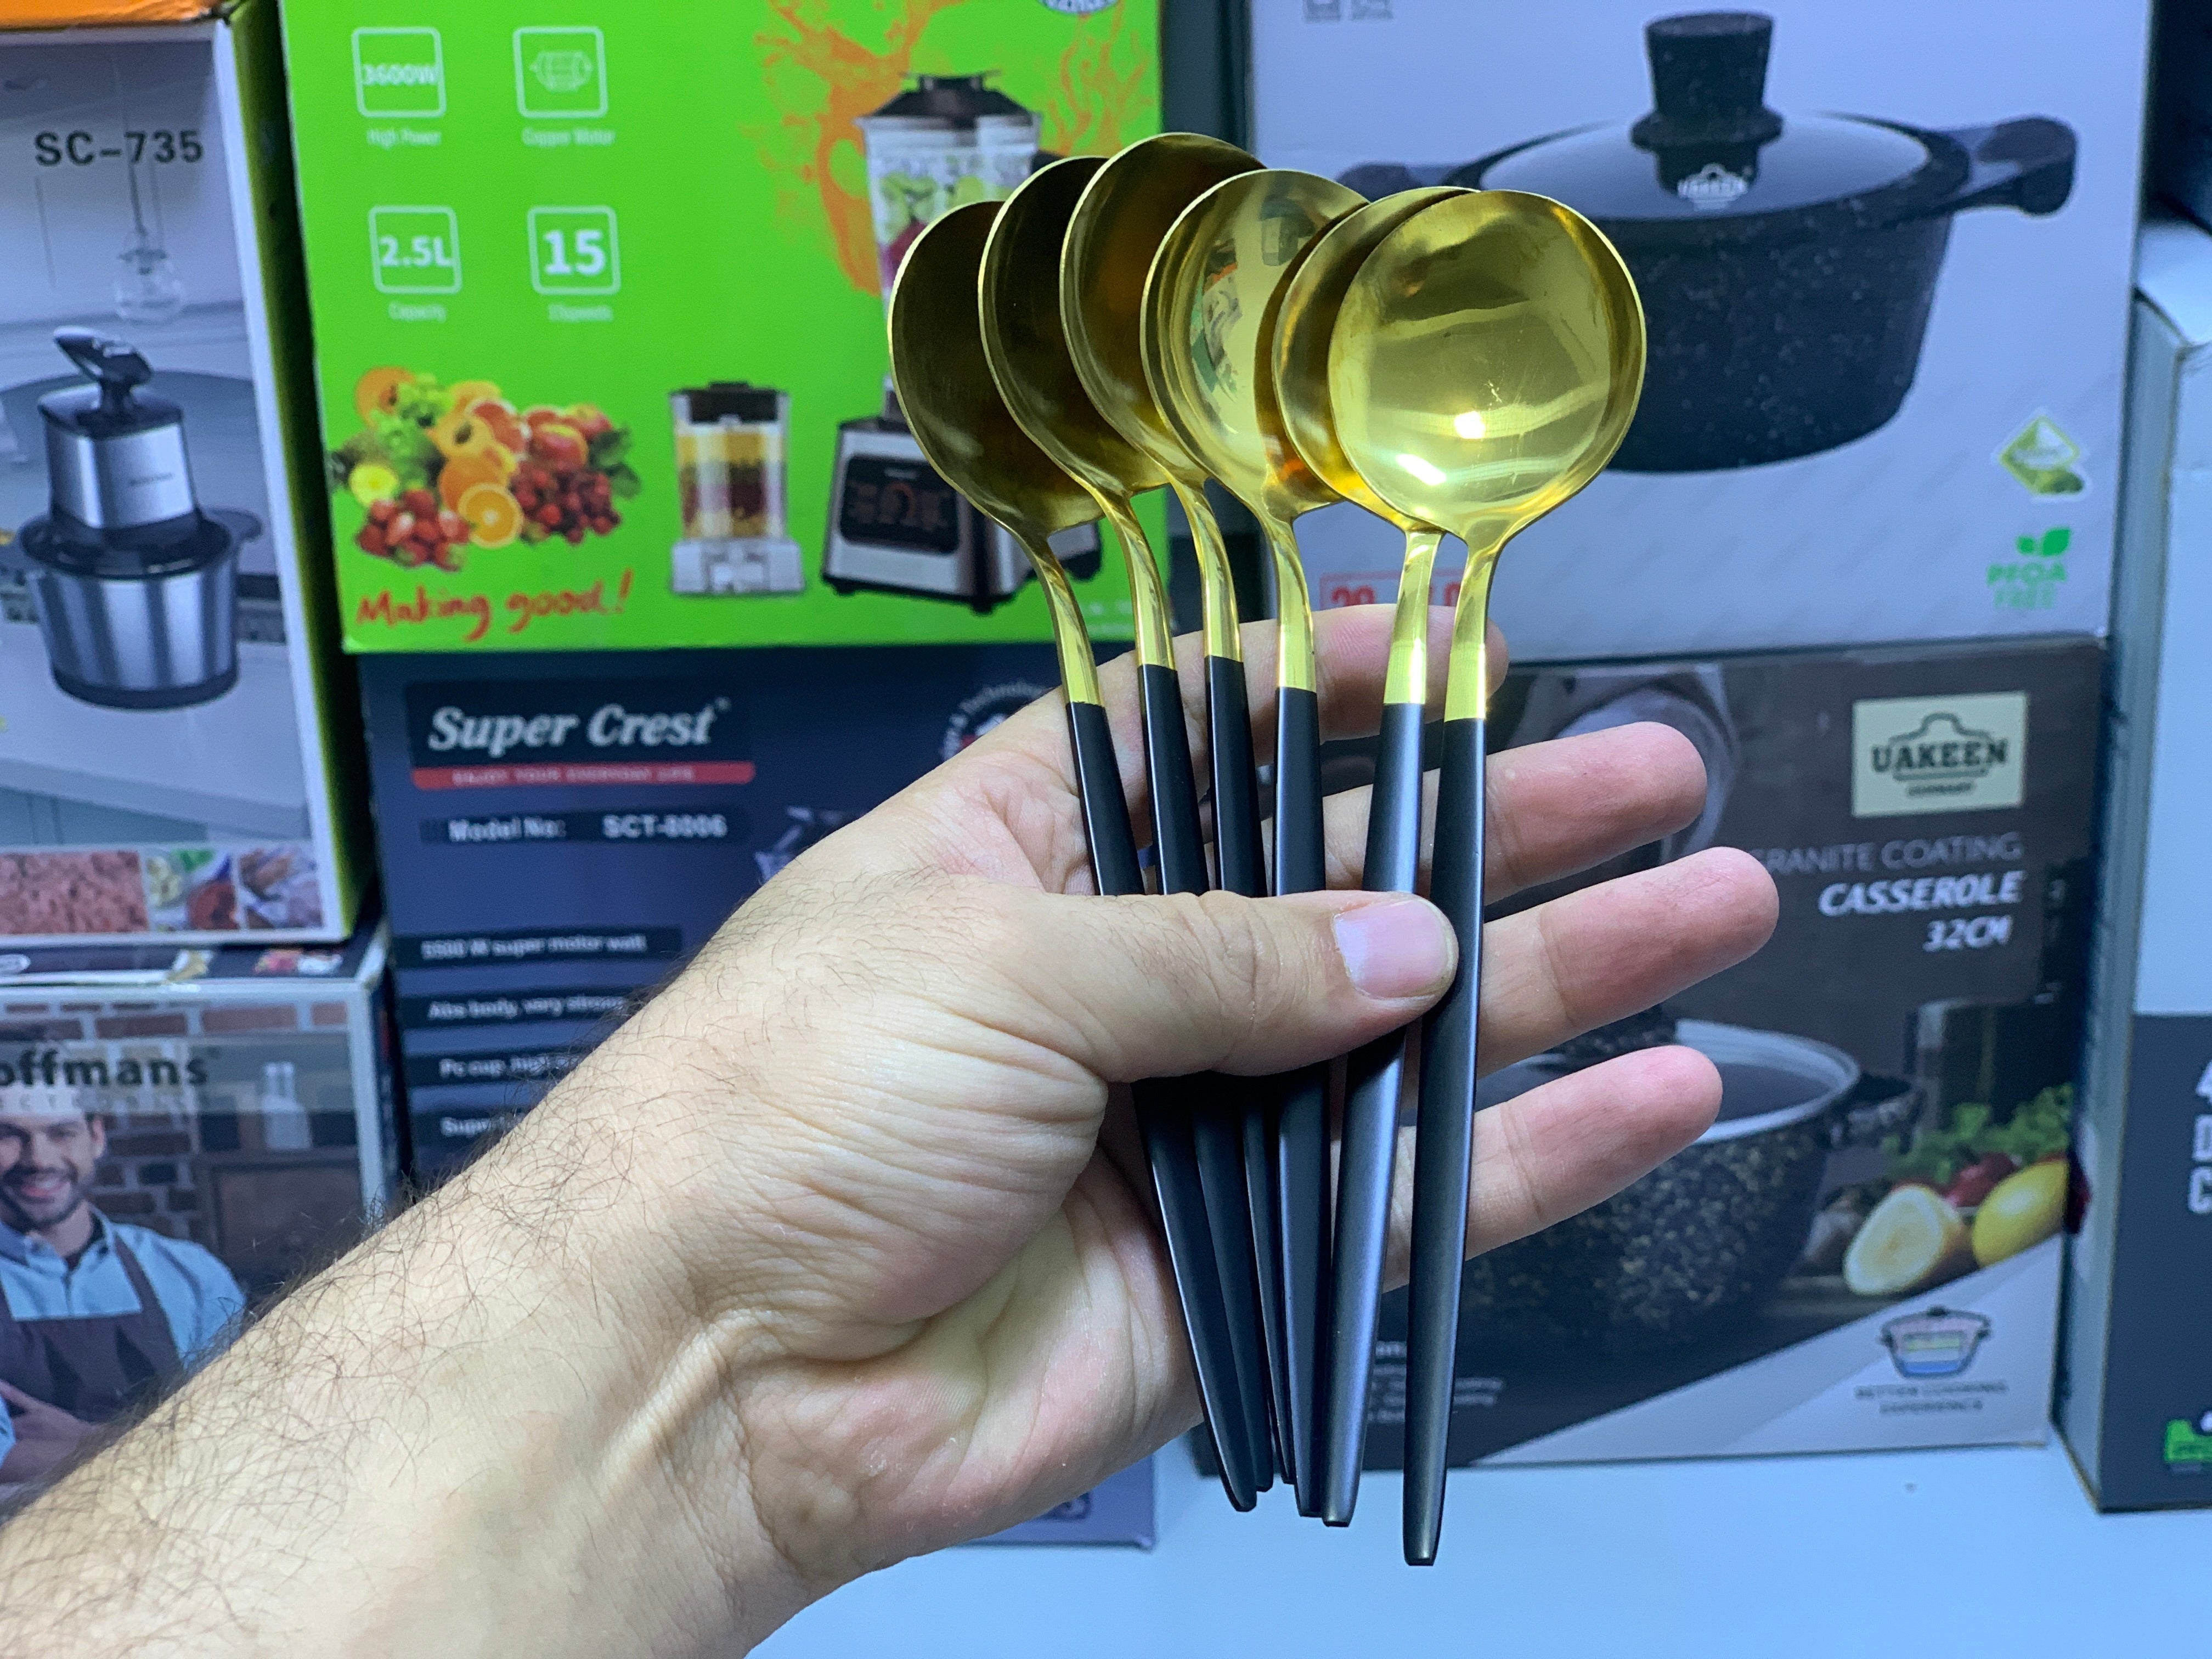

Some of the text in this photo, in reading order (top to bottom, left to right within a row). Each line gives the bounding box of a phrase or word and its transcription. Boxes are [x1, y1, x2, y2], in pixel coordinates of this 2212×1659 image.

[362, 64, 438, 86] 3600W
[33, 130, 204, 167] SC-735
[380, 235, 453, 267] 2.5L
[543, 229, 606, 275] 15
[356, 567, 634, 642] Making good!
[428, 703, 715, 758] Super Crest
[449, 817, 521, 843] Model
[1881, 831, 2024, 869] COATING
[1818, 870, 2028, 917] CASSEROLE
[1922, 915, 2013, 952] 32CM
